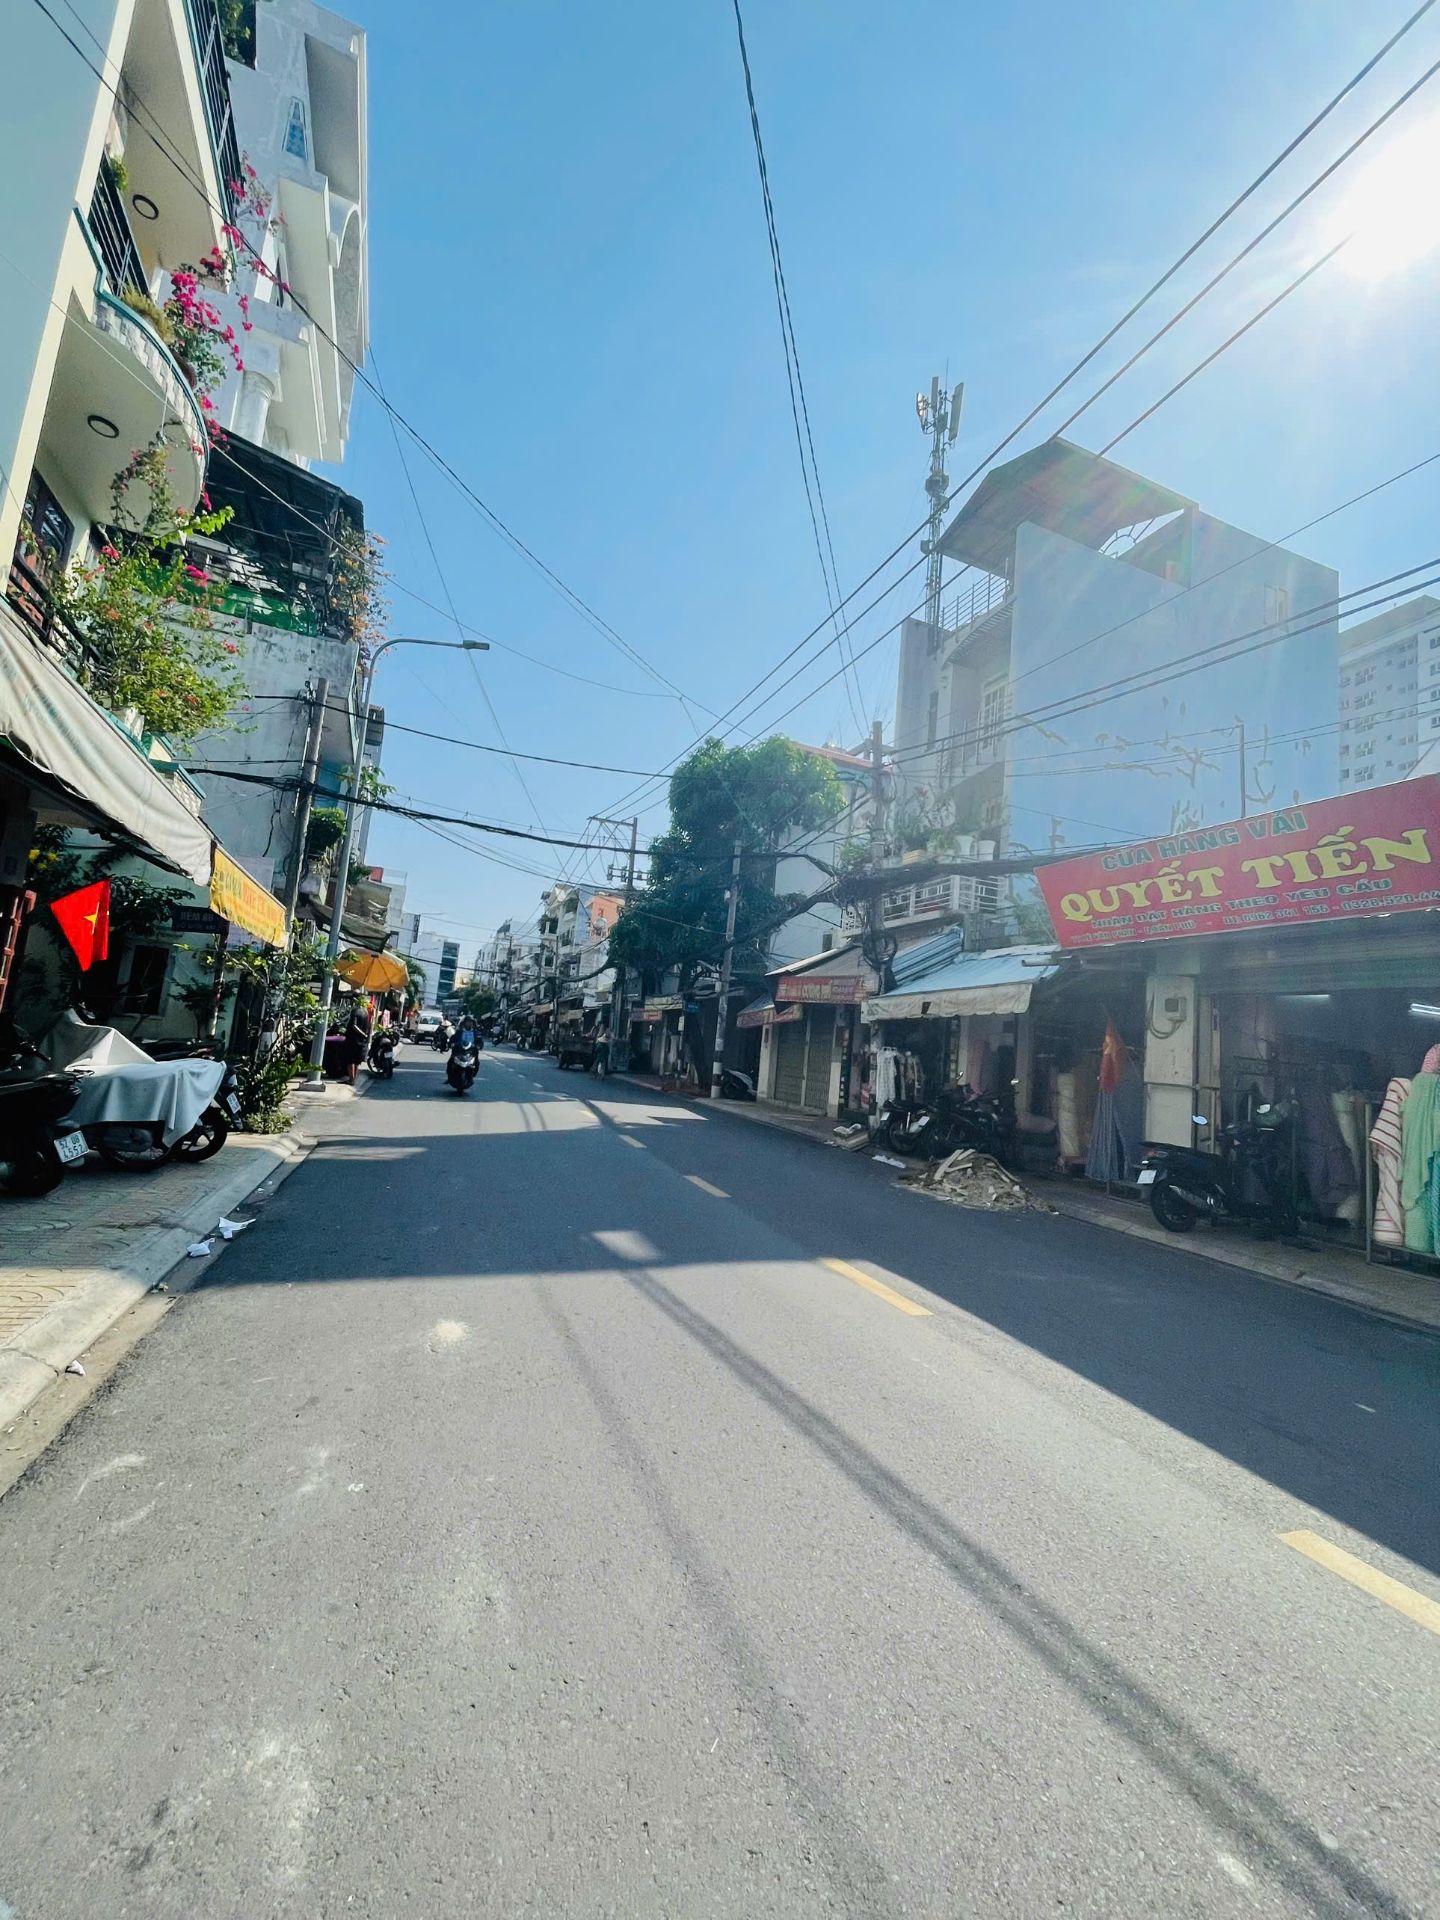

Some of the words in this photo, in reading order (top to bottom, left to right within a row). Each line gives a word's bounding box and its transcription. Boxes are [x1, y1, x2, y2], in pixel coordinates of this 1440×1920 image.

[1157, 826, 1242, 859] HÀNG
[1245, 810, 1309, 840] VẢI
[1060, 860, 1225, 921] QUYẾT
[1240, 825, 1432, 888] TIẾN
[1225, 895, 1279, 911] THEO
[1283, 887, 1330, 902] YÊU
[1336, 878, 1392, 895] CẦU
